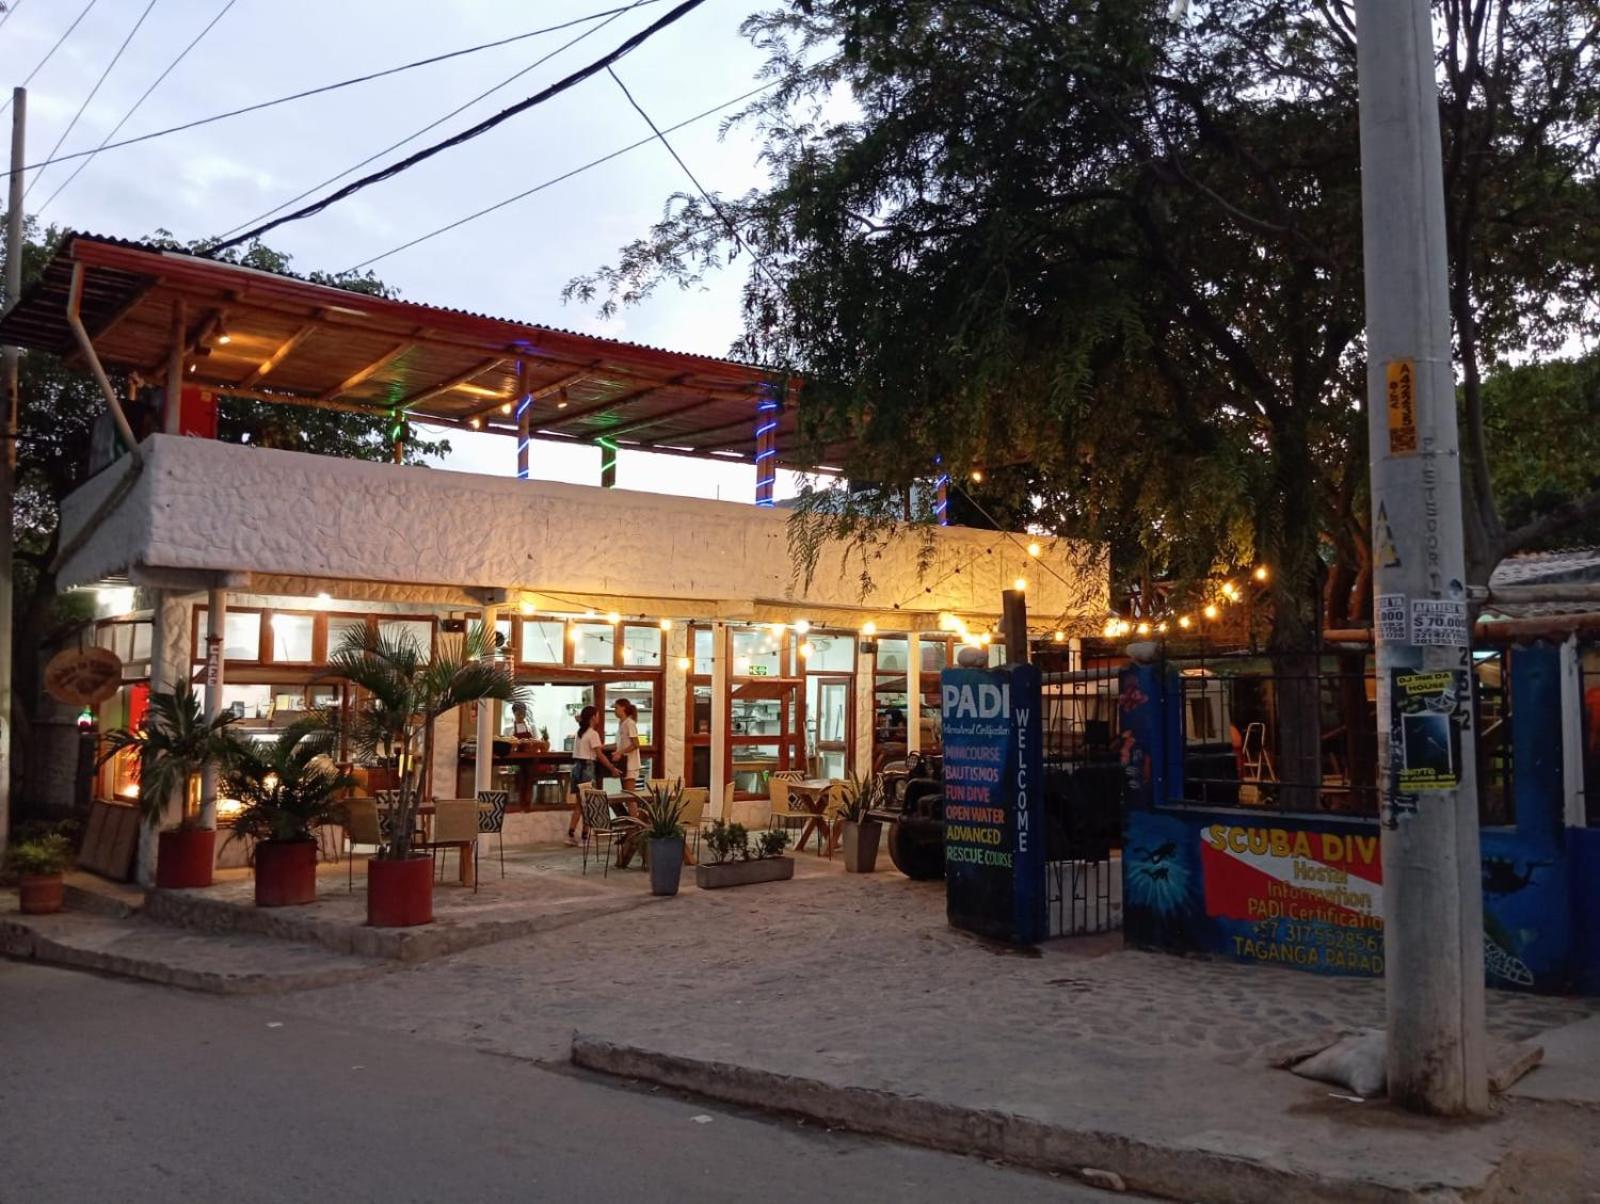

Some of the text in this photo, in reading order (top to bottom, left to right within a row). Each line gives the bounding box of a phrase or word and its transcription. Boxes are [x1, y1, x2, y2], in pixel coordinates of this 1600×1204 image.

[943, 684, 1010, 718] PADI
[945, 765, 999, 782] BAUTISMOS
[1016, 708, 1030, 852] WELCOME
[946, 784, 991, 803] FUN DIVE
[946, 805, 1005, 824] OPEN WATER
[947, 825, 1001, 845] ADVANCED
[1209, 824, 1312, 860] SCUBA
[947, 845, 1013, 868] RESCUE COURSE
[1248, 898, 1284, 919] PADI
[1233, 936, 1319, 965] TAGANGA
